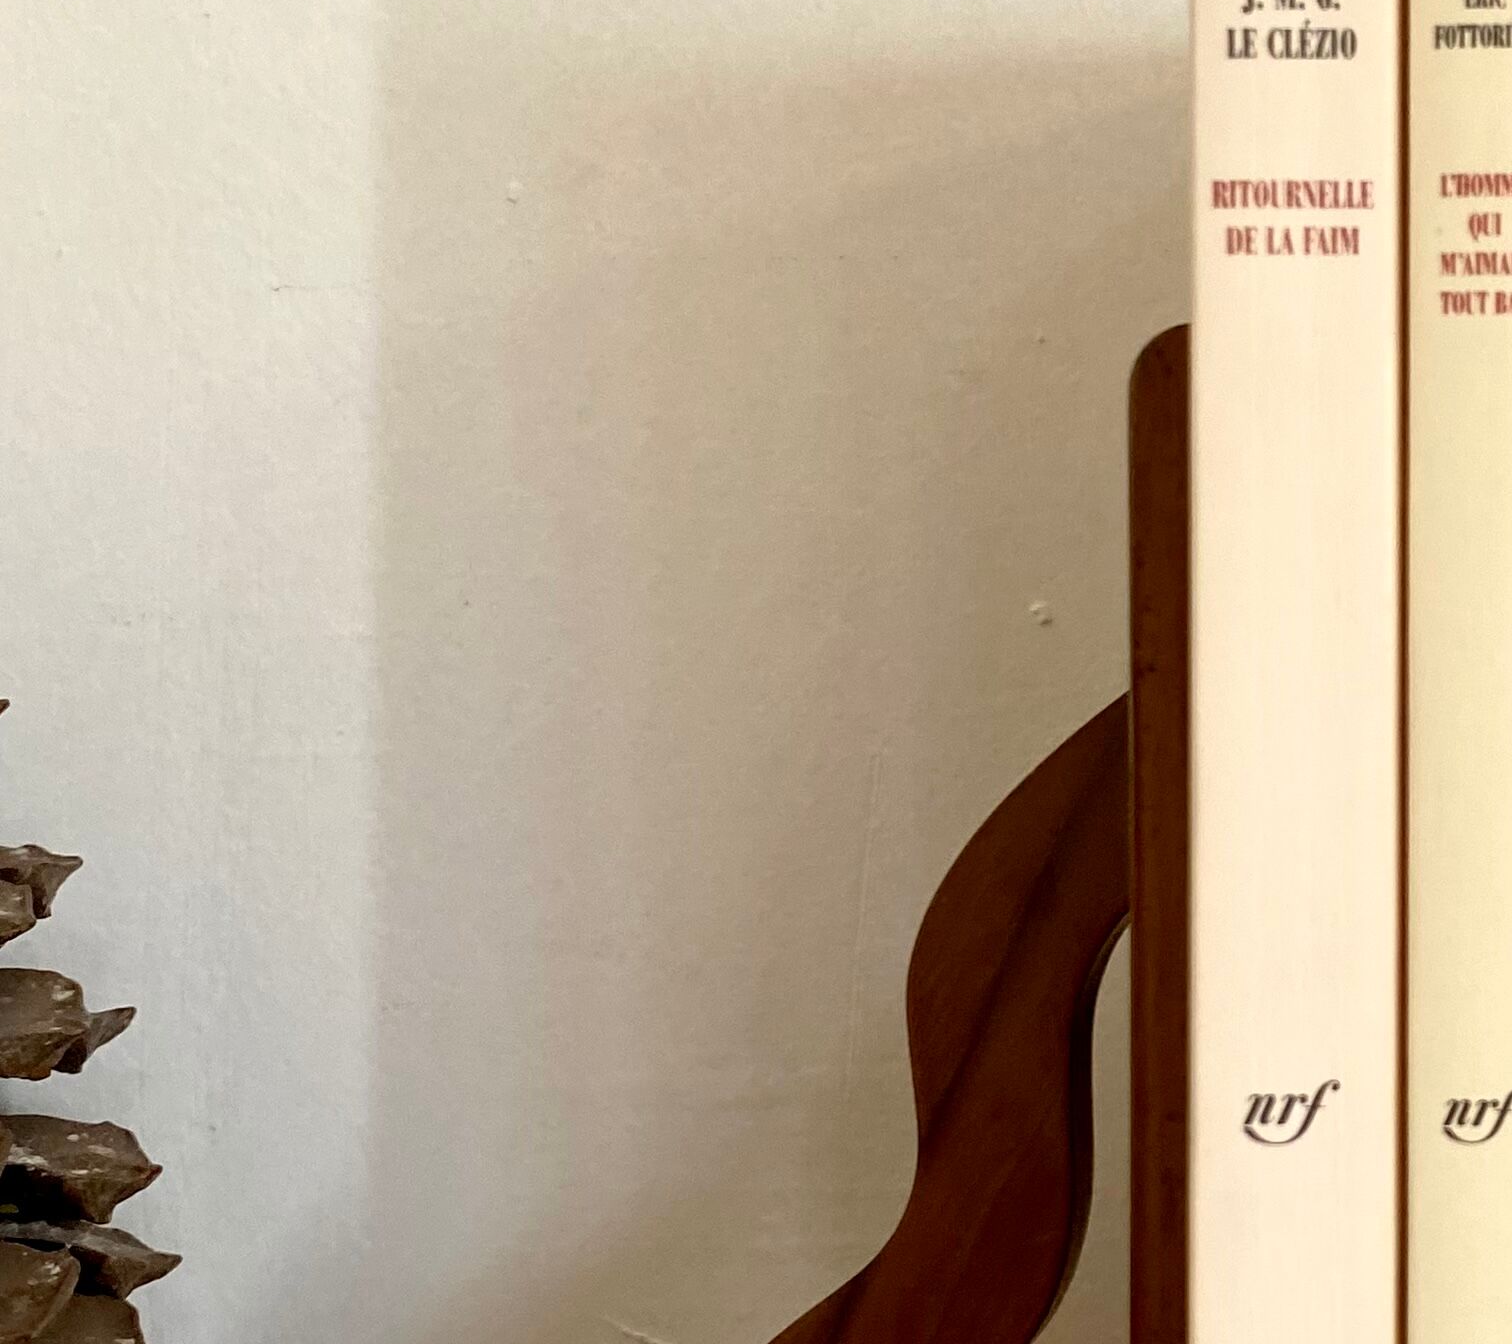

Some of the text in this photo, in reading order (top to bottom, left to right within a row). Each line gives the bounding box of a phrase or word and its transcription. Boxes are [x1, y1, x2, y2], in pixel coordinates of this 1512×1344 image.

[1226, 19, 1357, 59] LE CLÉZIO
[1211, 179, 1373, 209] RITOURNELLE
[1467, 212, 1501, 238] QUI
[1226, 226, 1359, 256] DE LA FAIM
[1440, 290, 1489, 315] TOUT
[1243, 1080, 1340, 1144] nrf
